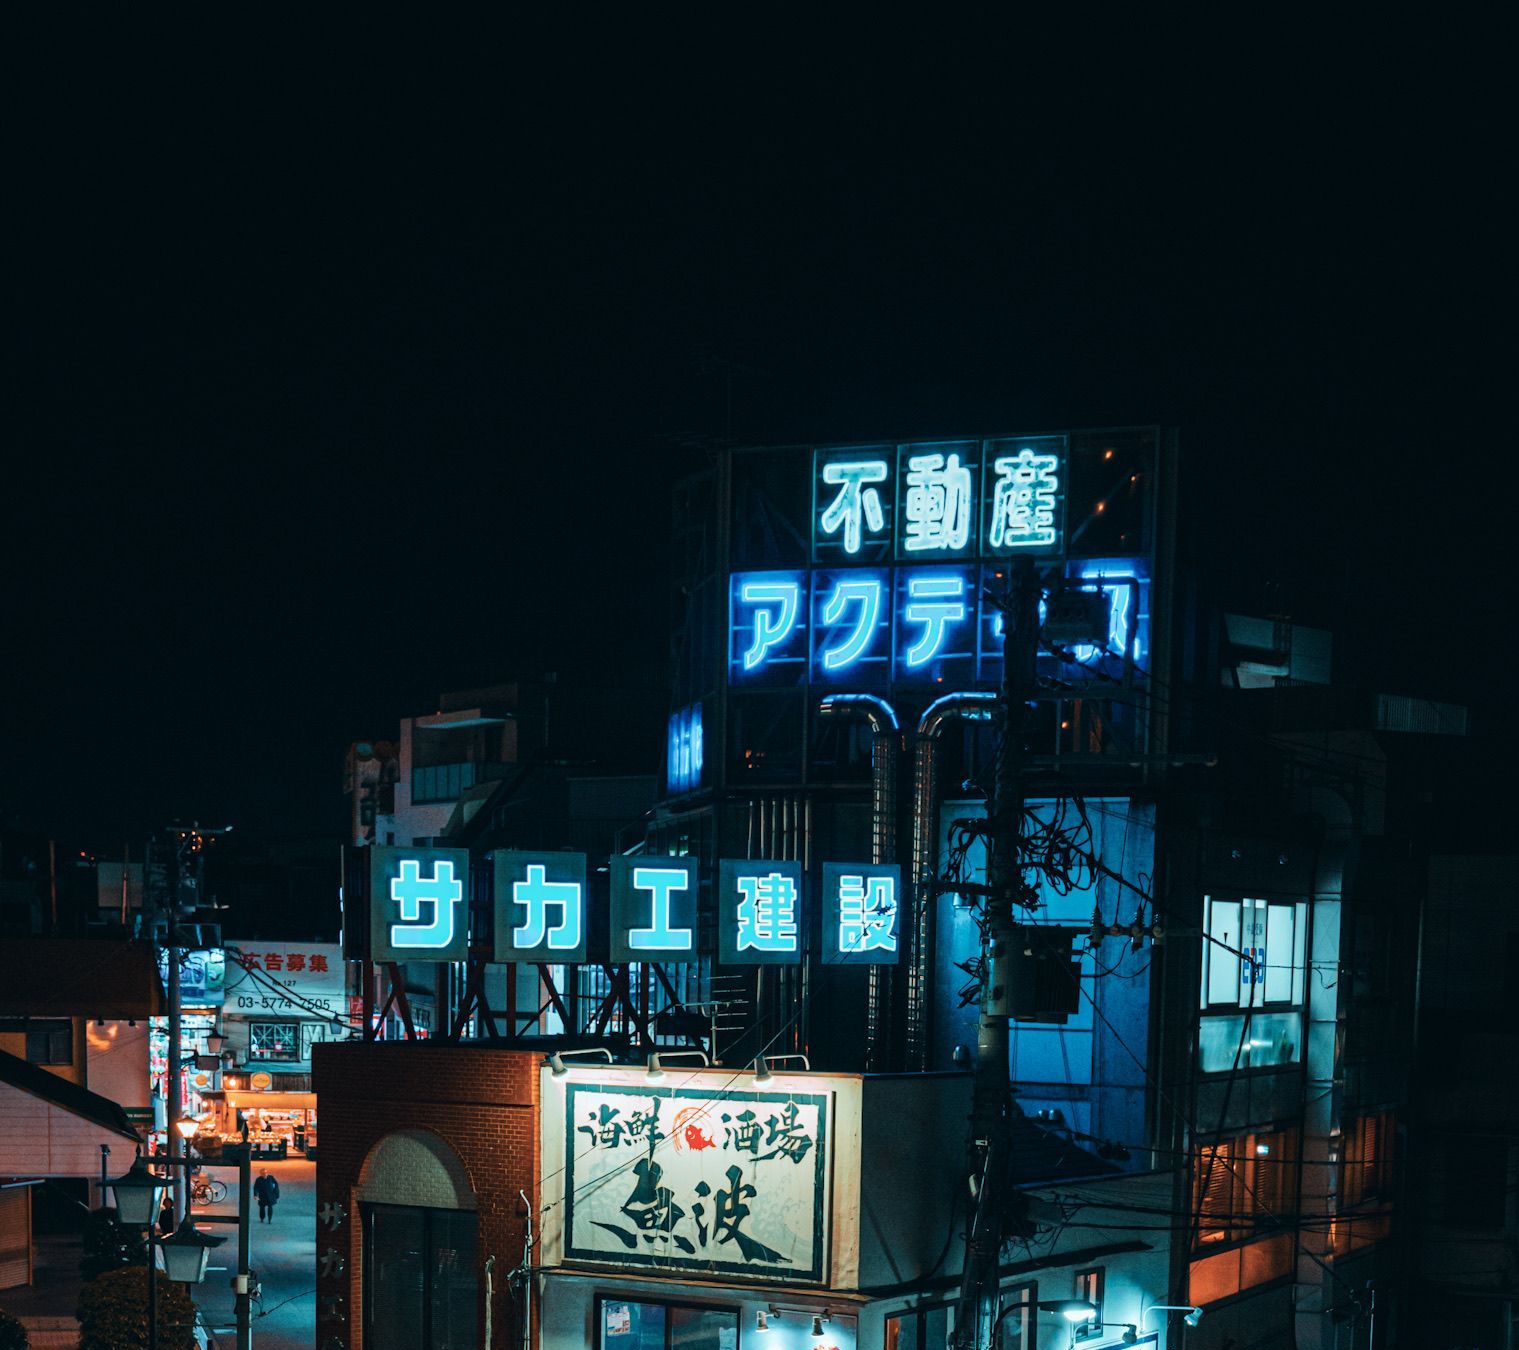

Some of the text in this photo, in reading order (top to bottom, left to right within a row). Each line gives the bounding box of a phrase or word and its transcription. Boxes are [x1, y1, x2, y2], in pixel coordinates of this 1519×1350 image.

[822, 448, 1058, 554] 不動産
[390, 859, 898, 953] サカエ建設
[237, 996, 331, 1010] 03-57747505
[241, 952, 328, 973] 広告募集
[577, 1096, 815, 1165] 海鮮 酒場
[588, 1158, 793, 1264] 魚波
